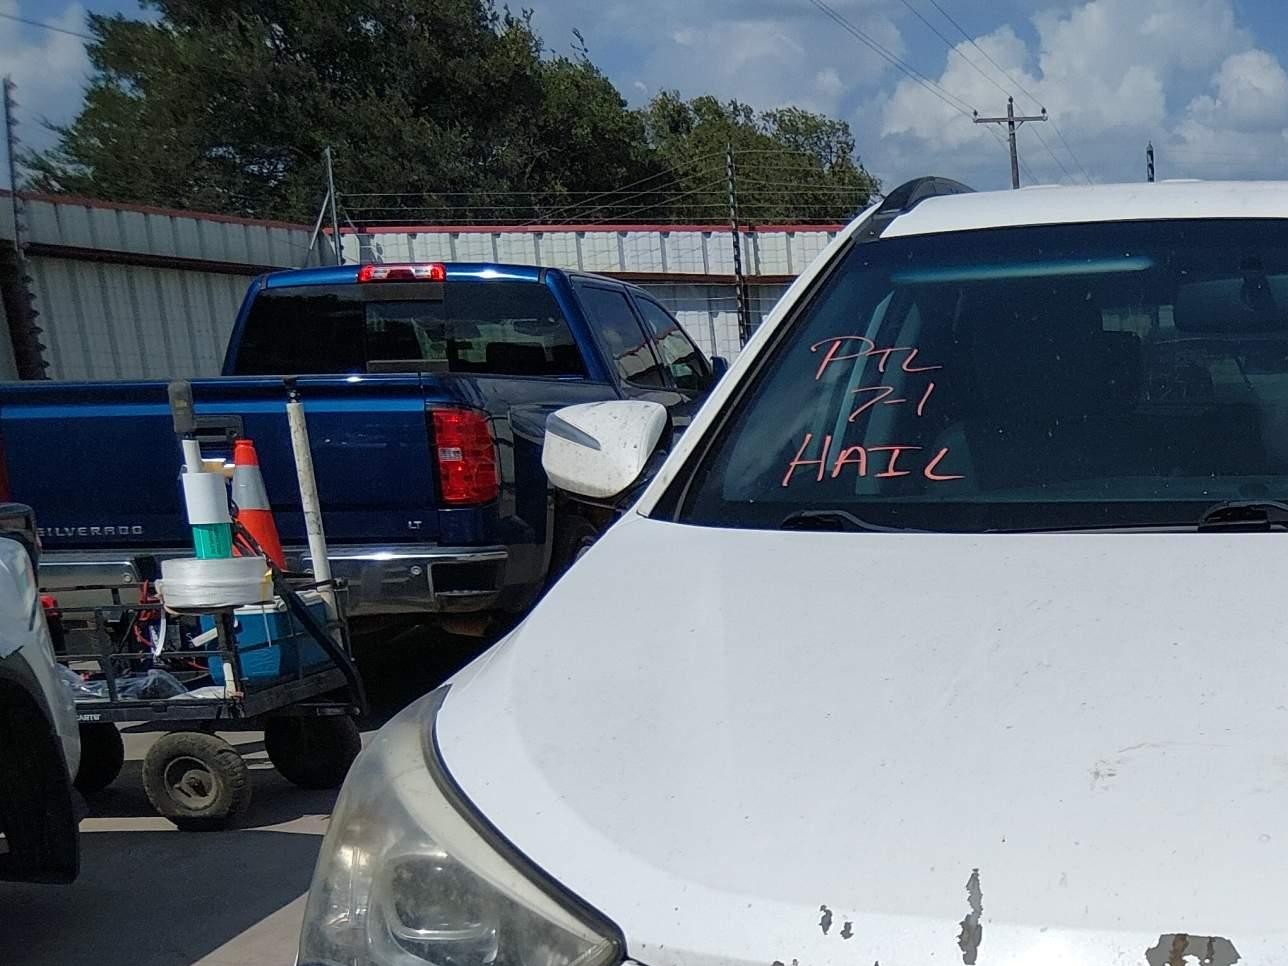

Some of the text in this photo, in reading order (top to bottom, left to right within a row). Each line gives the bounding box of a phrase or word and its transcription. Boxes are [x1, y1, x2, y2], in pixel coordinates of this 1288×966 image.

[810, 335, 944, 381] PTL
[781, 432, 966, 488] HAIL
[36, 525, 143, 537] SILVERADO
[407, 520, 423, 530] LT
